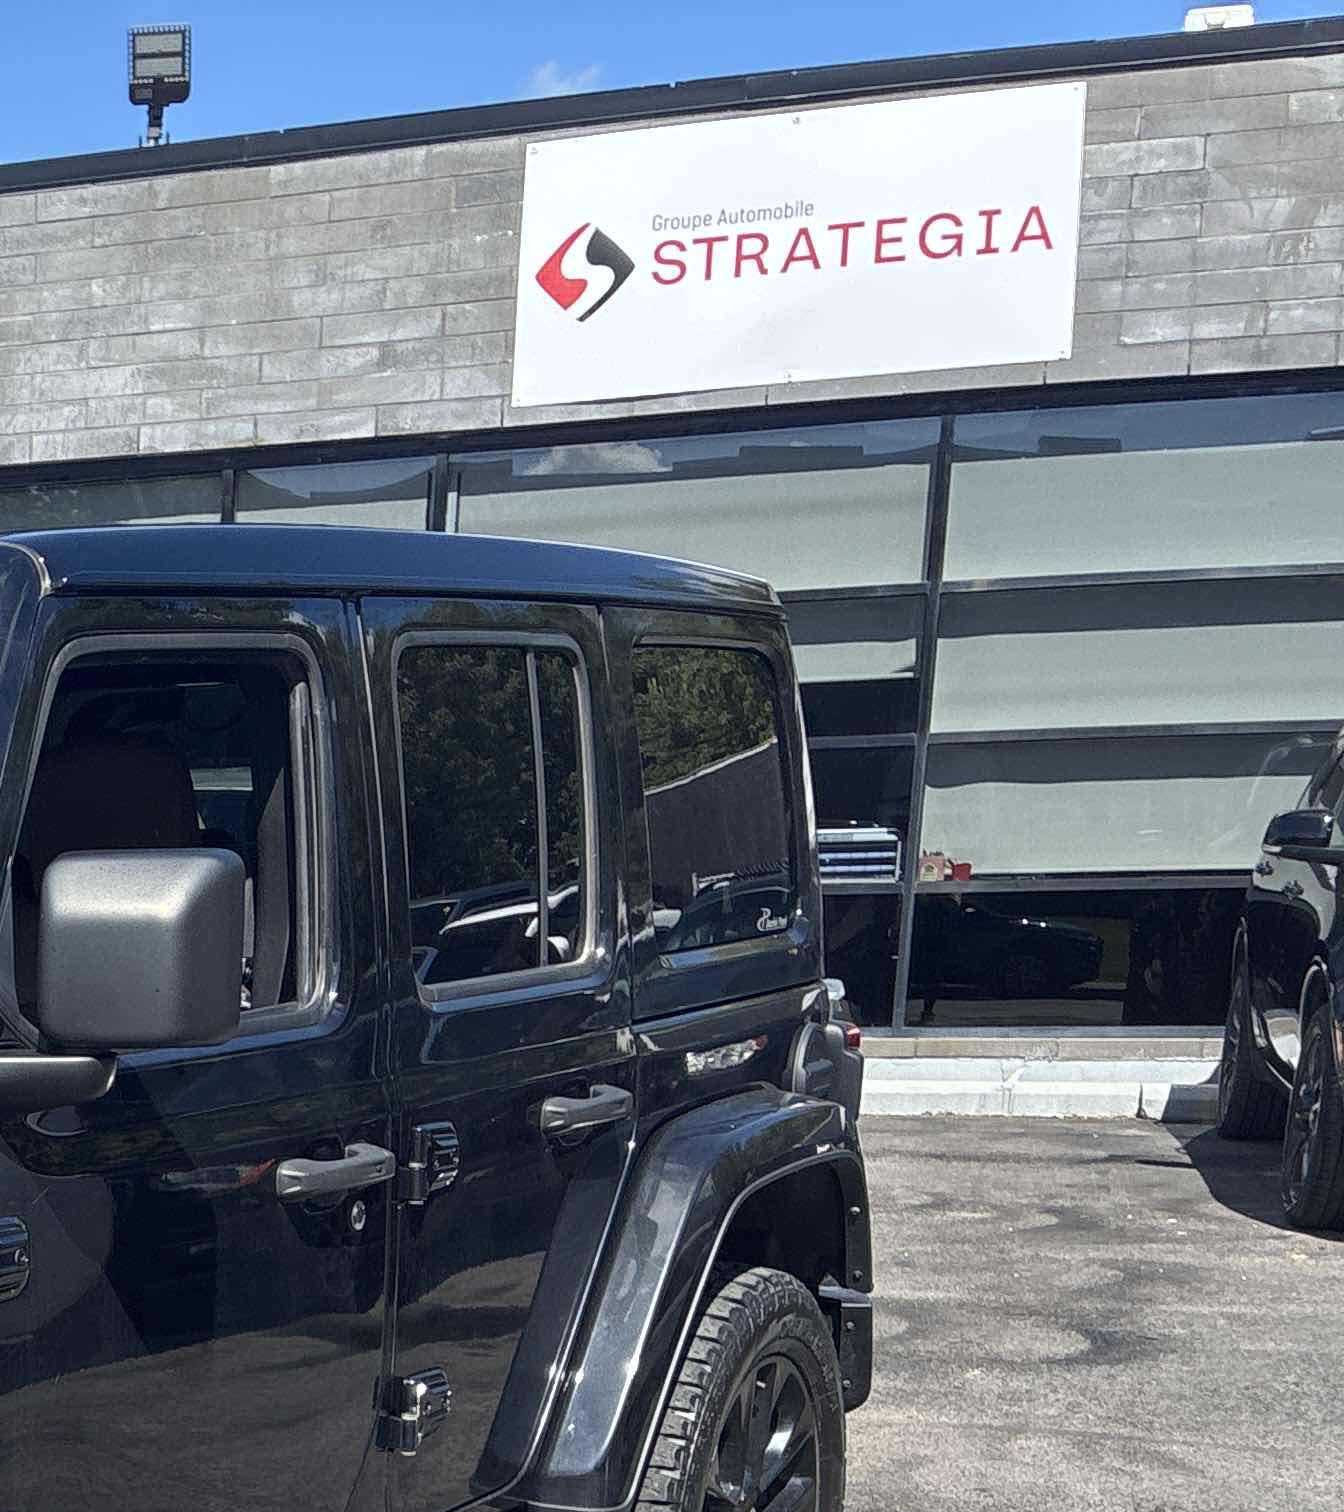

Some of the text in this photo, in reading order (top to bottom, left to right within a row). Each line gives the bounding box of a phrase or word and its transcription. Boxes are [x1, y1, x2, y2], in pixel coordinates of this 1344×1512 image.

[651, 199, 815, 232] Groupe Automobile
[651, 205, 1055, 286] STRATEGIA
